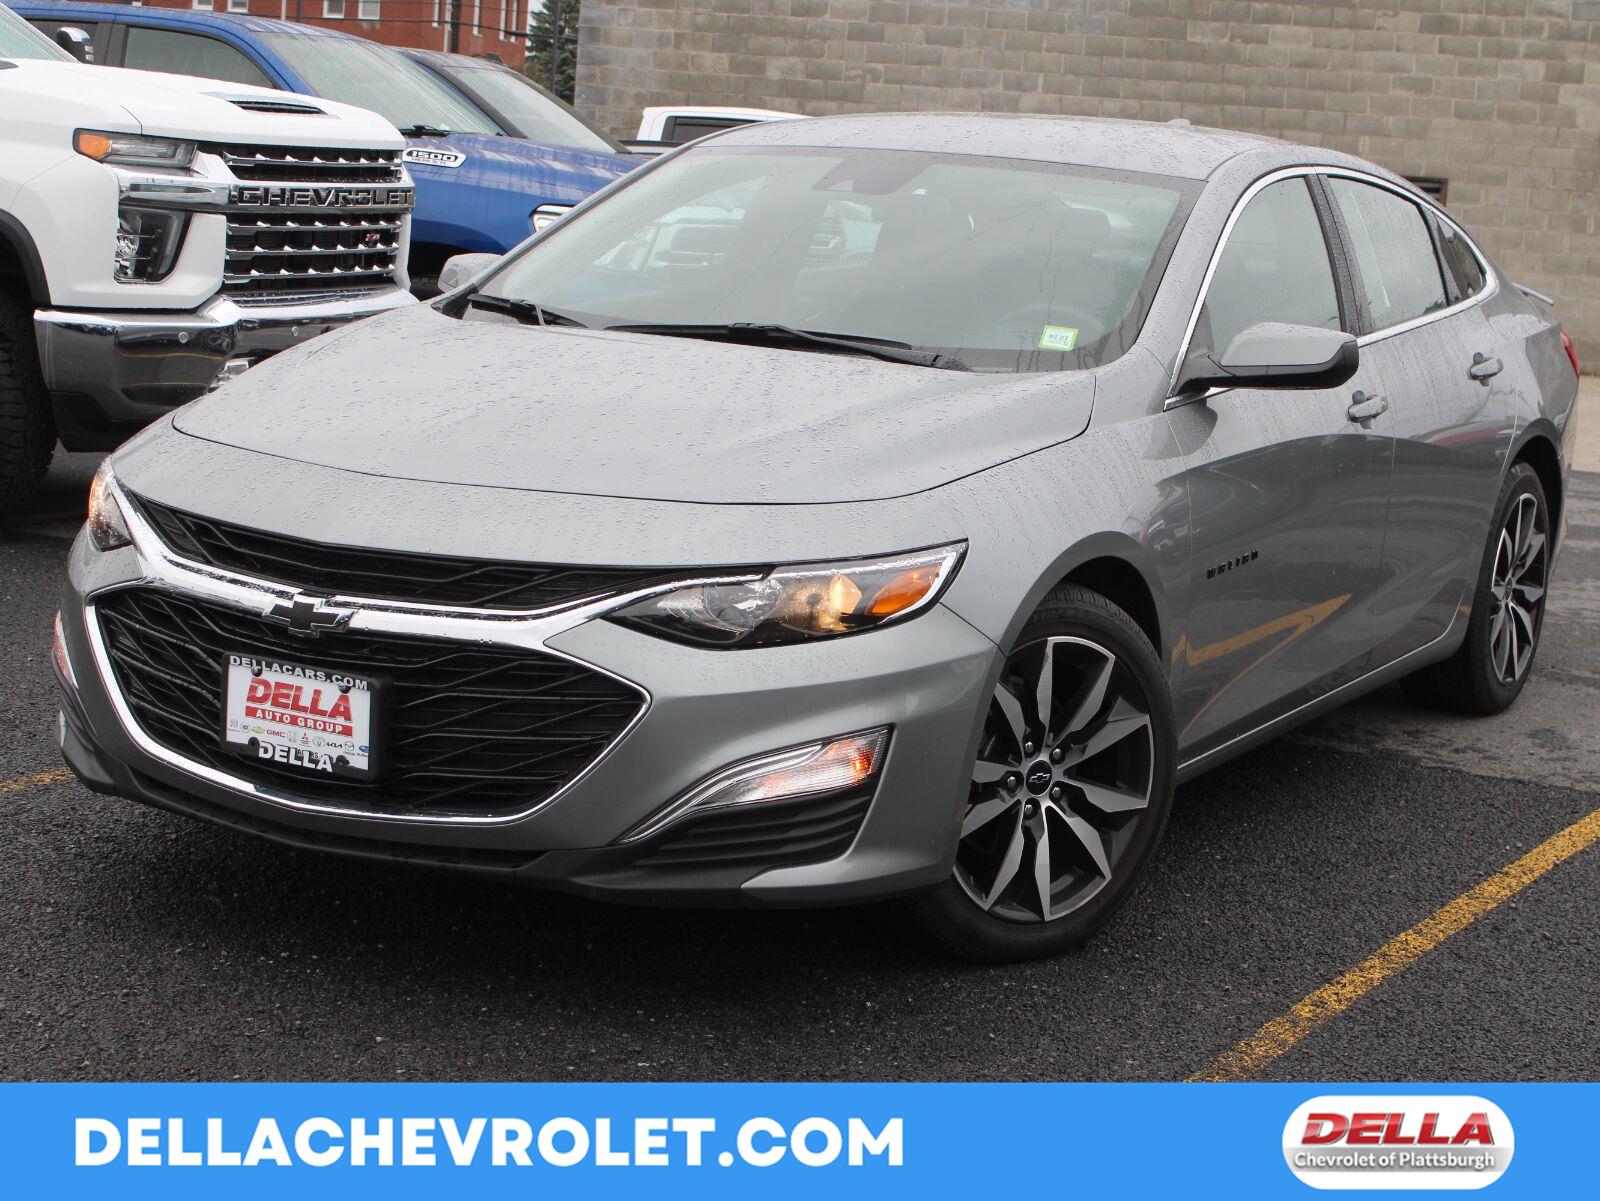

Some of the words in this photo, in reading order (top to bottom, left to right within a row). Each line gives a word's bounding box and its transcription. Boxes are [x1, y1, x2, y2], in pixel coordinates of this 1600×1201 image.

[411, 150, 457, 162] 1500
[236, 187, 412, 207] CHEVROLET
[1206, 549, 1259, 579] MALIBU
[229, 655, 369, 691] DELLACARS.COM
[246, 677, 353, 722] DELLA
[255, 708, 291, 724] AUTO
[296, 717, 344, 734] GROUP
[266, 729, 286, 738] GMC
[258, 741, 333, 772] DELLA
